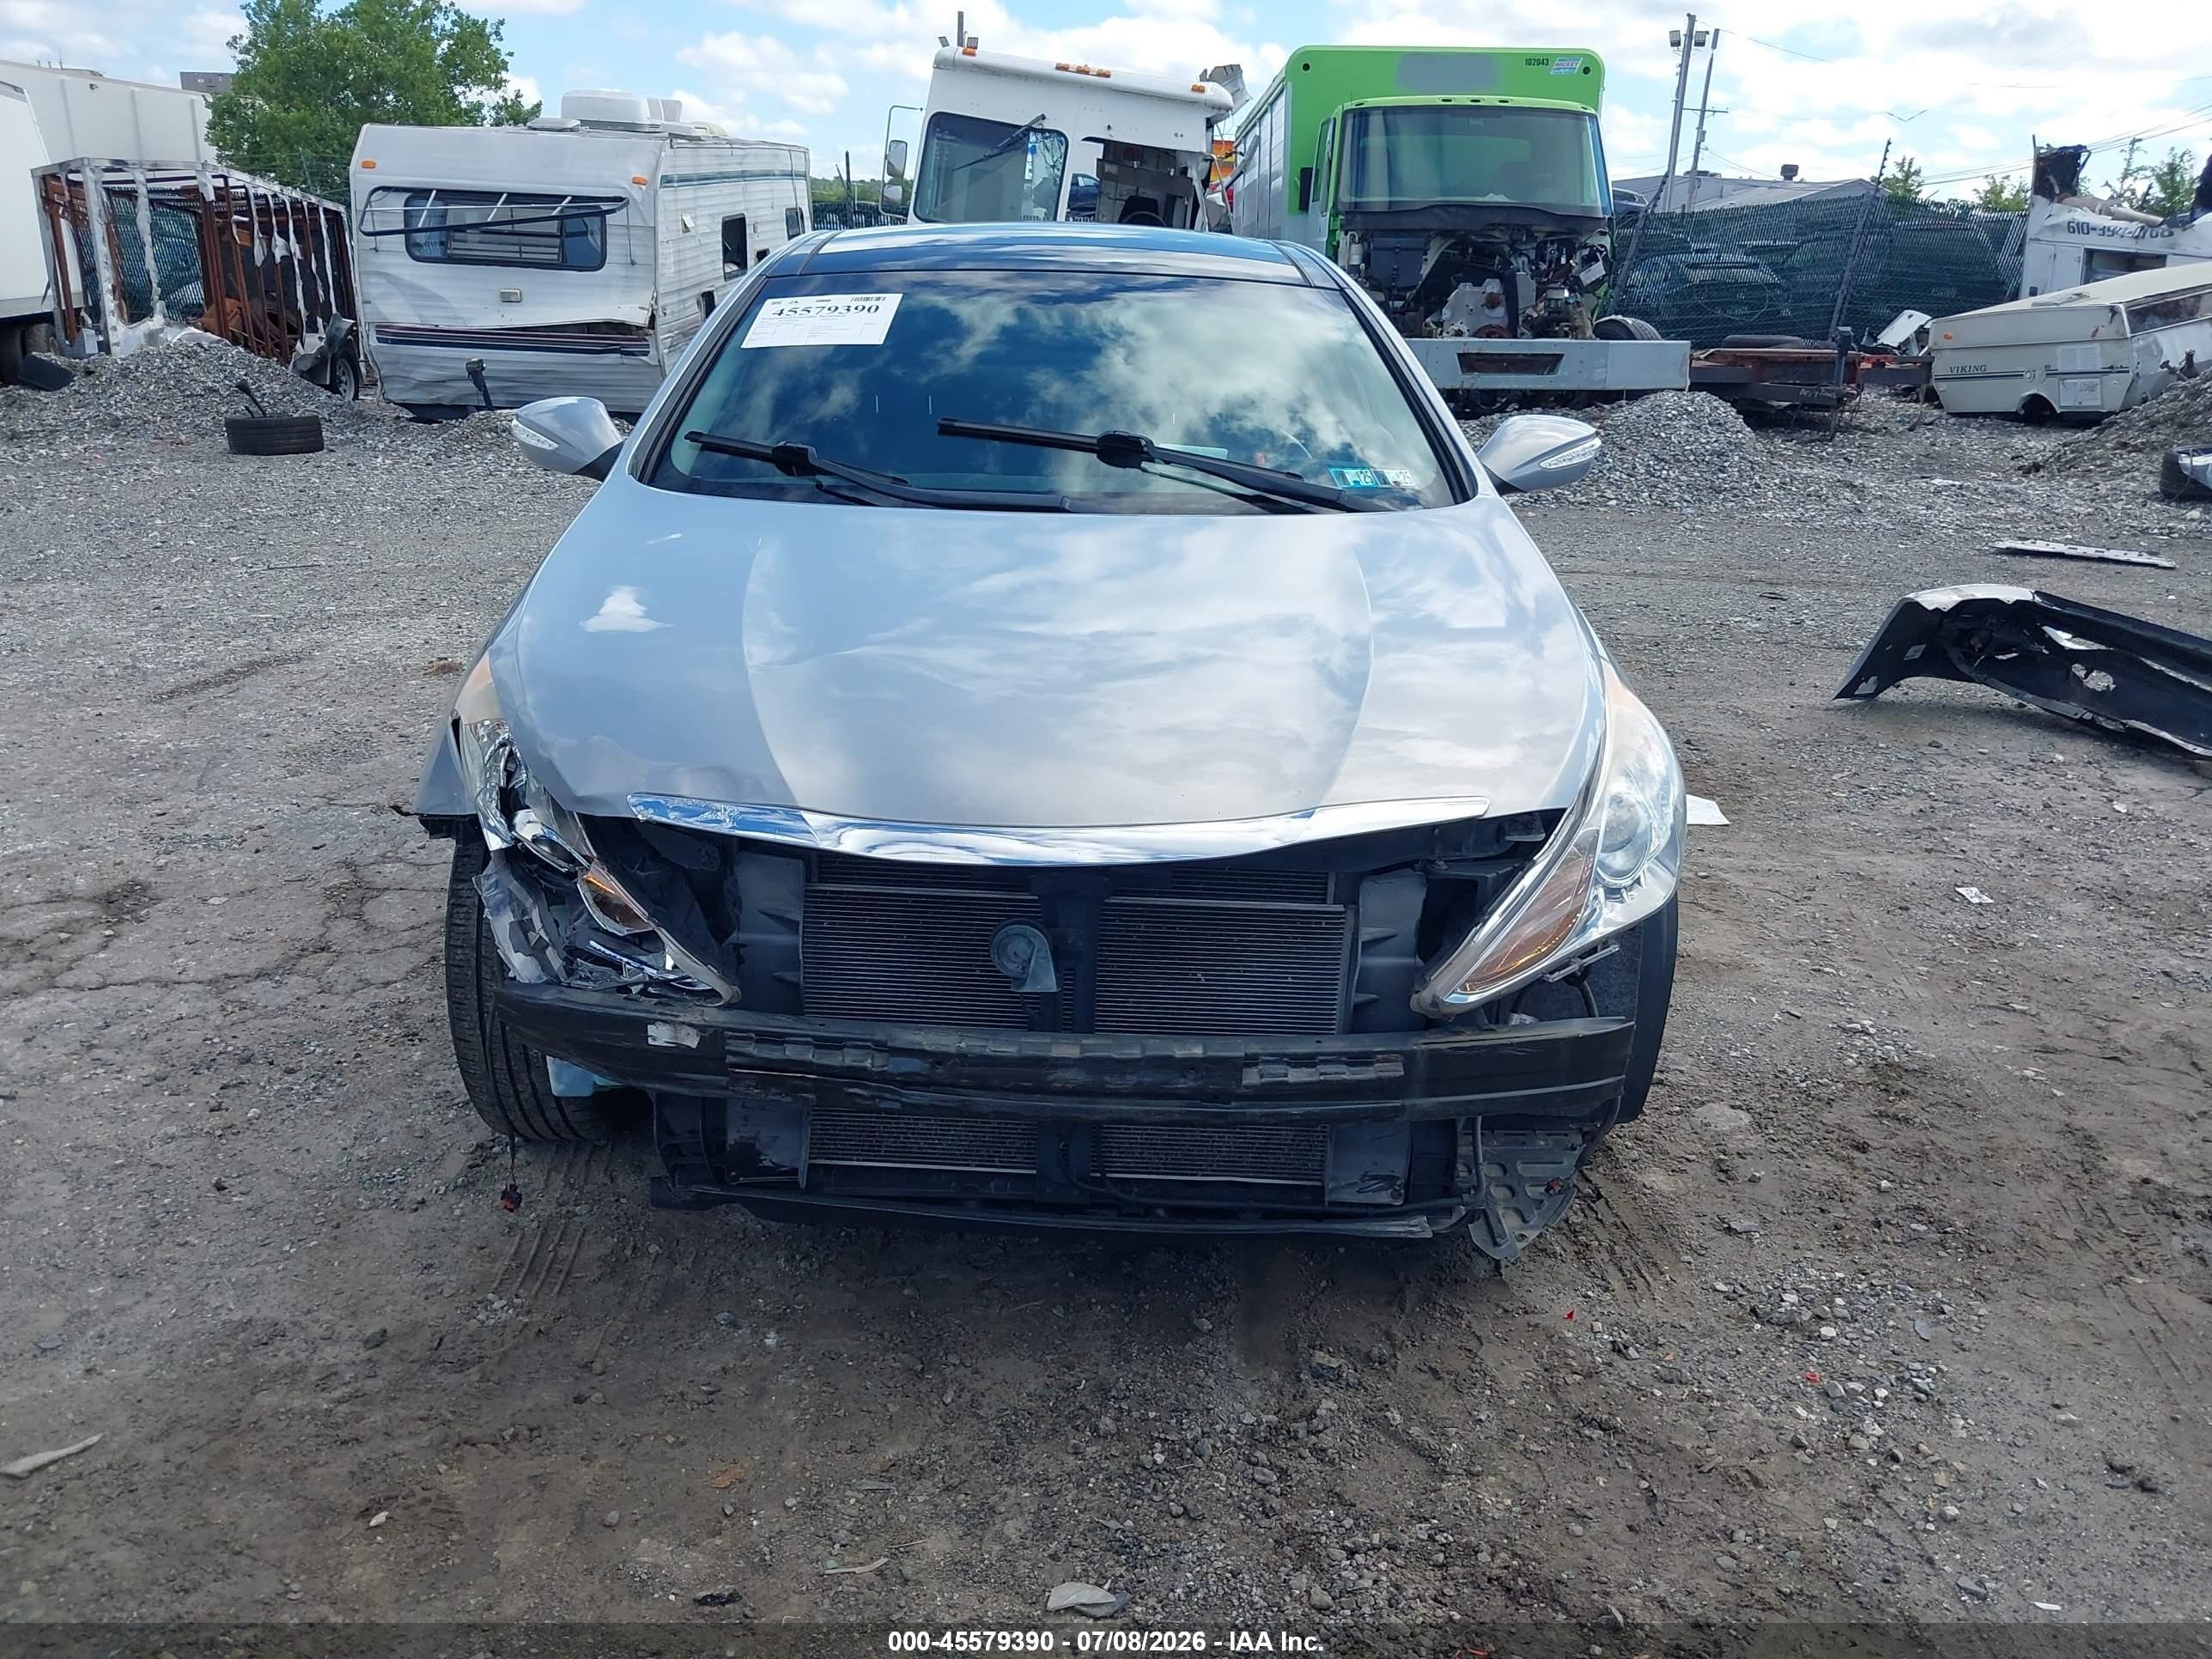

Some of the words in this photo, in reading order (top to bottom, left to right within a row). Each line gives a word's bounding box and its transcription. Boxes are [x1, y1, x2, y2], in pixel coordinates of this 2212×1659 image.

[1525, 58, 1549, 66] 102043
[772, 304, 881, 317] 45579390
[1949, 365, 1987, 374] VIKING
